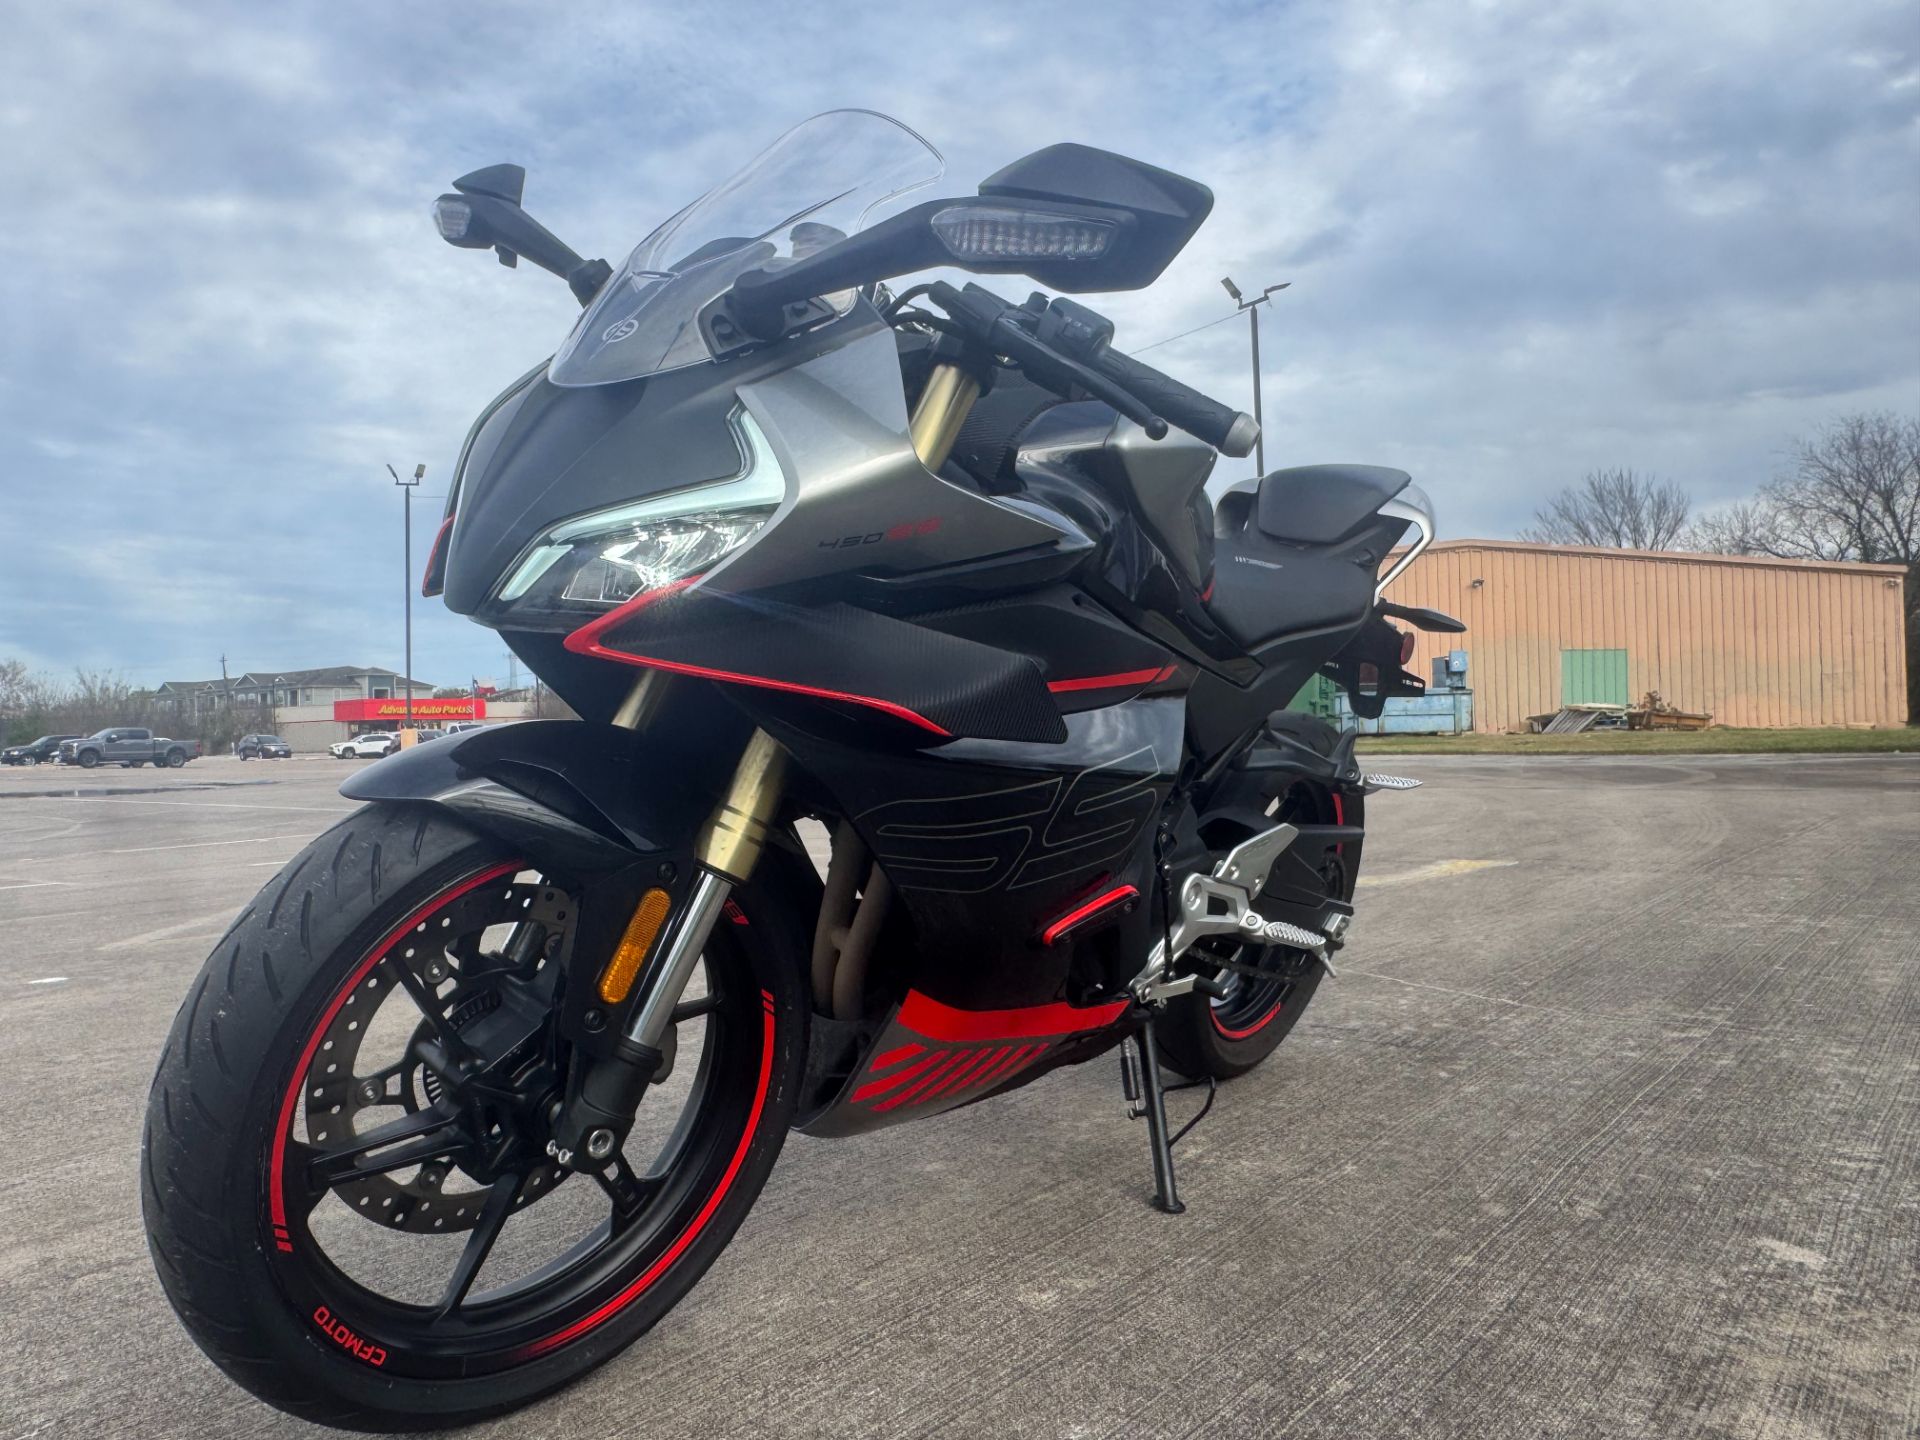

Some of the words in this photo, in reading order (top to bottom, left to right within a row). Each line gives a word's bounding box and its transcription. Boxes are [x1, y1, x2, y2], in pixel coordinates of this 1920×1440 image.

[378, 705, 418, 714] Advane
[418, 704, 442, 714] Auto
[442, 704, 466, 714] Parts
[313, 1305, 387, 1366] CFMOTO
